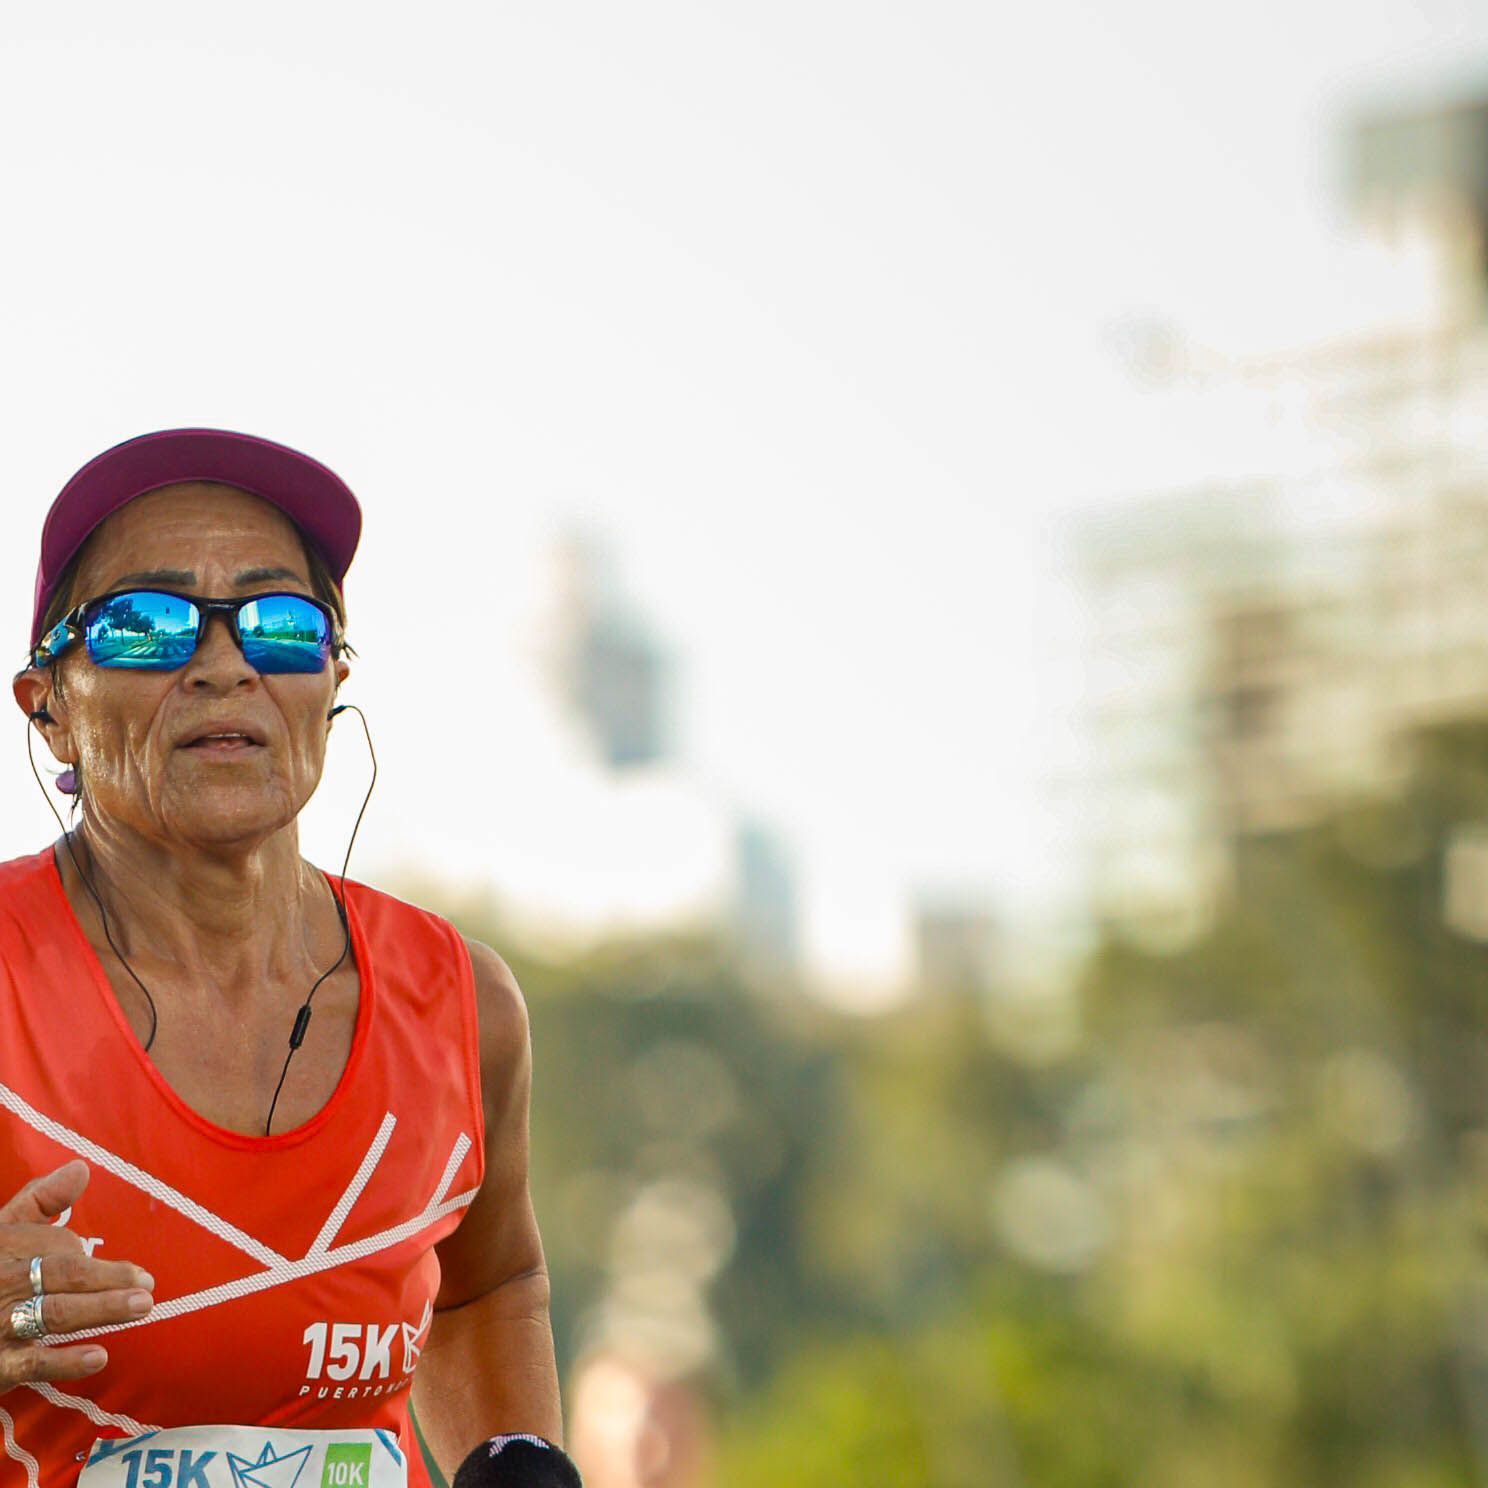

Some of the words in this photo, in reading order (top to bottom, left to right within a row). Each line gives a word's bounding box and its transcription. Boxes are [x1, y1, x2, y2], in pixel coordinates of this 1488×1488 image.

[302, 1322, 400, 1381] 15K
[298, 1385, 383, 1399] PUERTO
[327, 1461, 365, 1486] 10K
